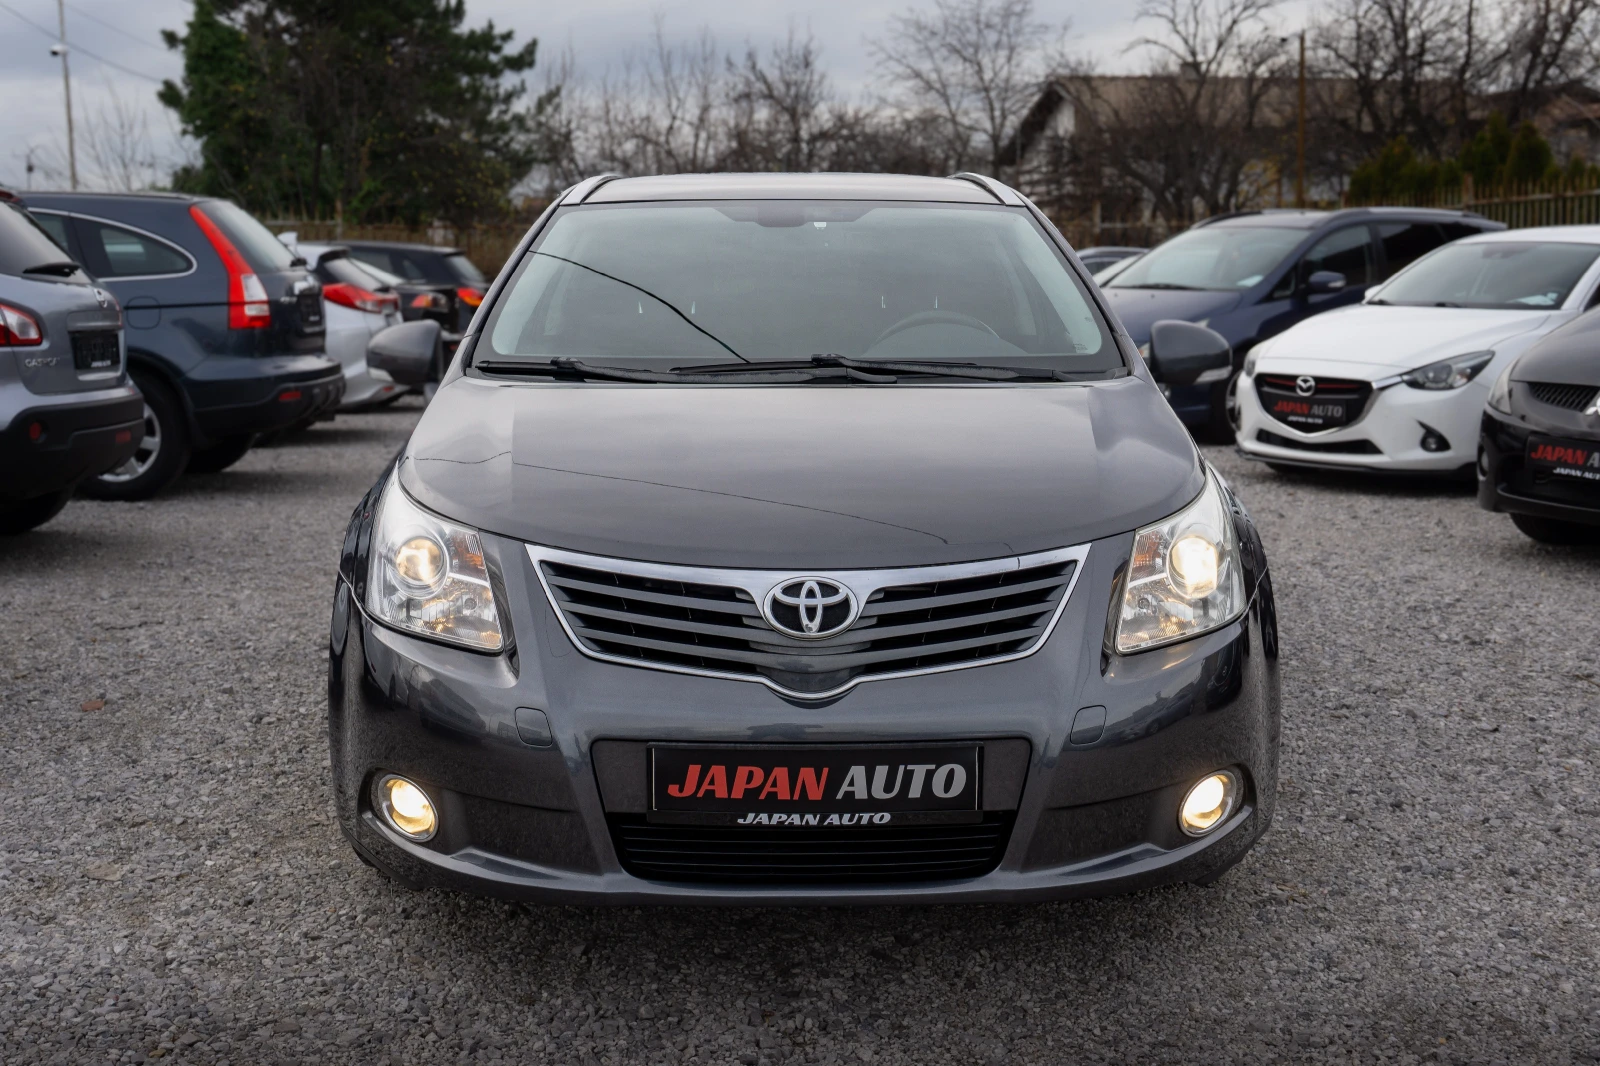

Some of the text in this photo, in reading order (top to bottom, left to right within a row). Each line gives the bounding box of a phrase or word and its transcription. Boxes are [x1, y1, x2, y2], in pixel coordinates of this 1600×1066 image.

[1273, 400, 1343, 417] JAPAN AUTO
[1530, 444, 1588, 466] JAPAN
[1552, 467, 1600, 480] JAPAN AUT
[667, 763, 967, 800] JAPAN AUTO
[737, 812, 891, 826] JAPAN AUTO
